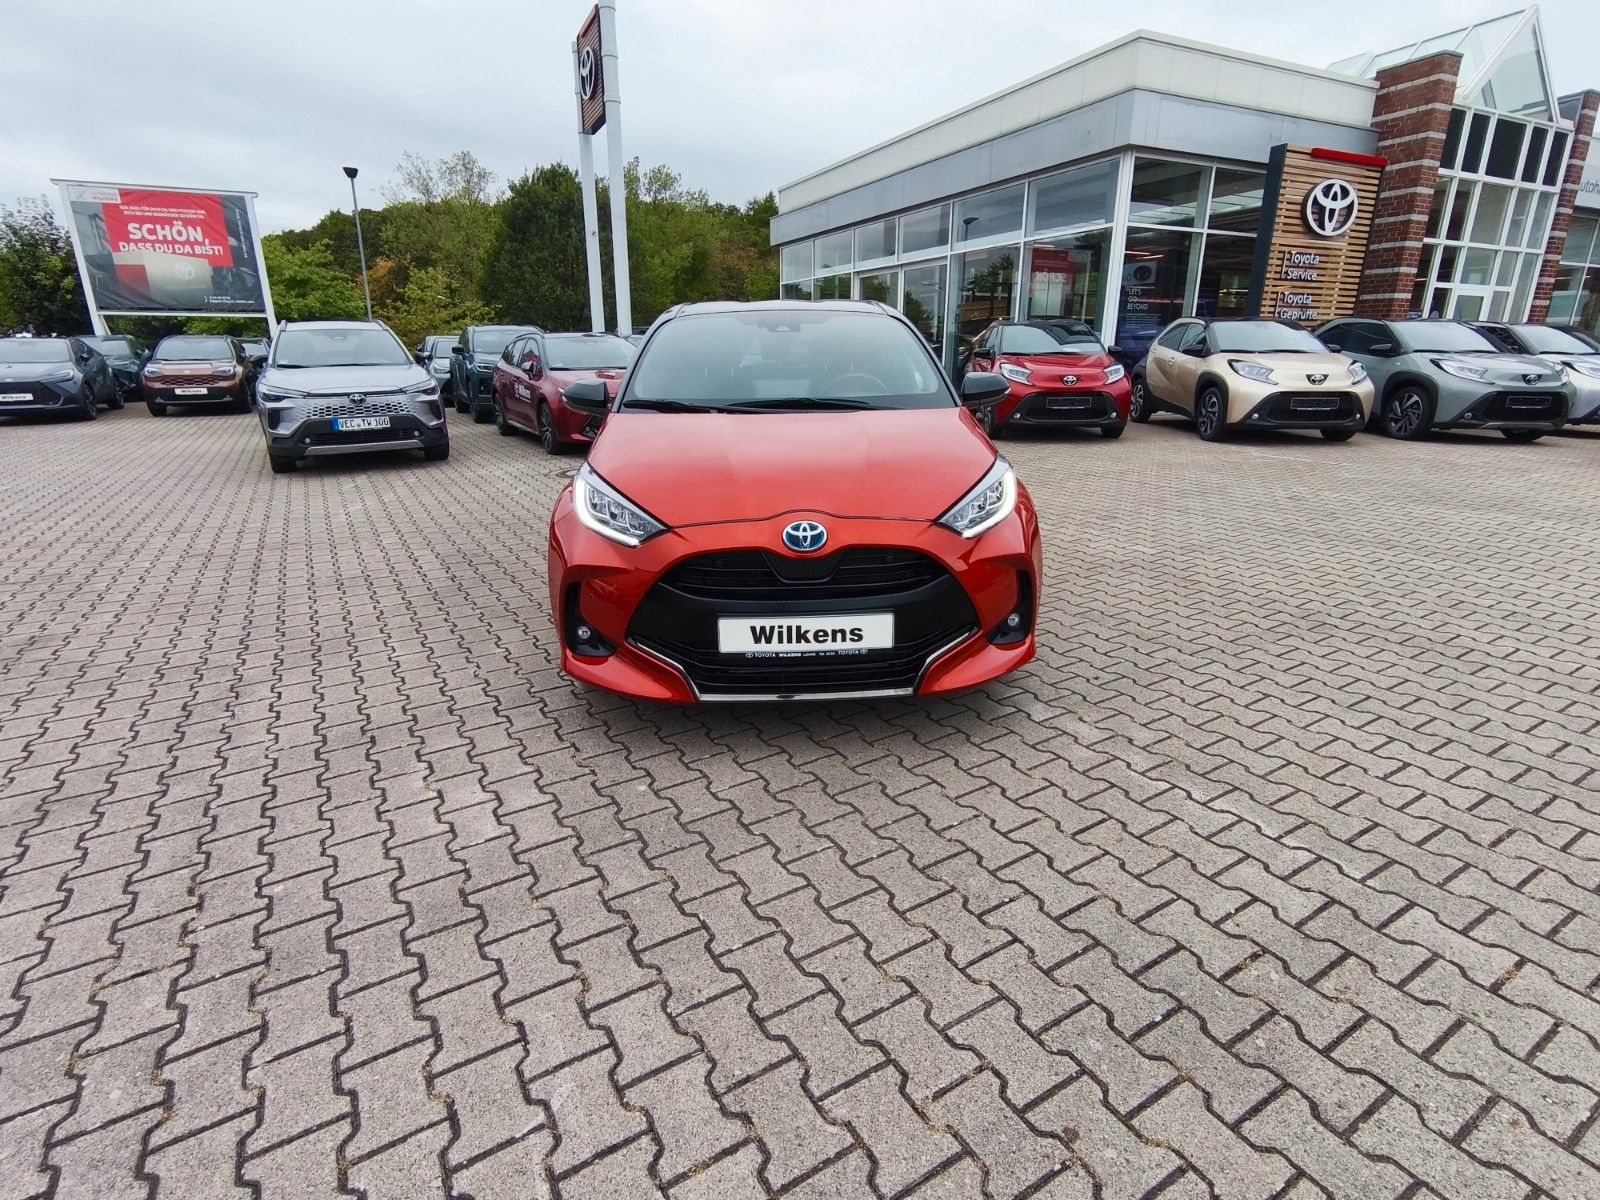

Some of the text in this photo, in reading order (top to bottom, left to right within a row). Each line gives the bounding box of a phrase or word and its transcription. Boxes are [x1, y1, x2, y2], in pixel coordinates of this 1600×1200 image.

[1579, 179, 1600, 195] utoh
[127, 220, 209, 245] SCHÖN,
[119, 242, 152, 253] DASS
[154, 244, 173, 254] DU
[175, 245, 192, 255] DA
[1290, 250, 1319, 266] Toyota
[1286, 268, 1317, 280] Service
[1283, 291, 1312, 306] Toyota
[1280, 308, 1318, 320] Geprüfte
[339, 418, 389, 429] VEC TW 100
[750, 625, 864, 645] Wilkens
